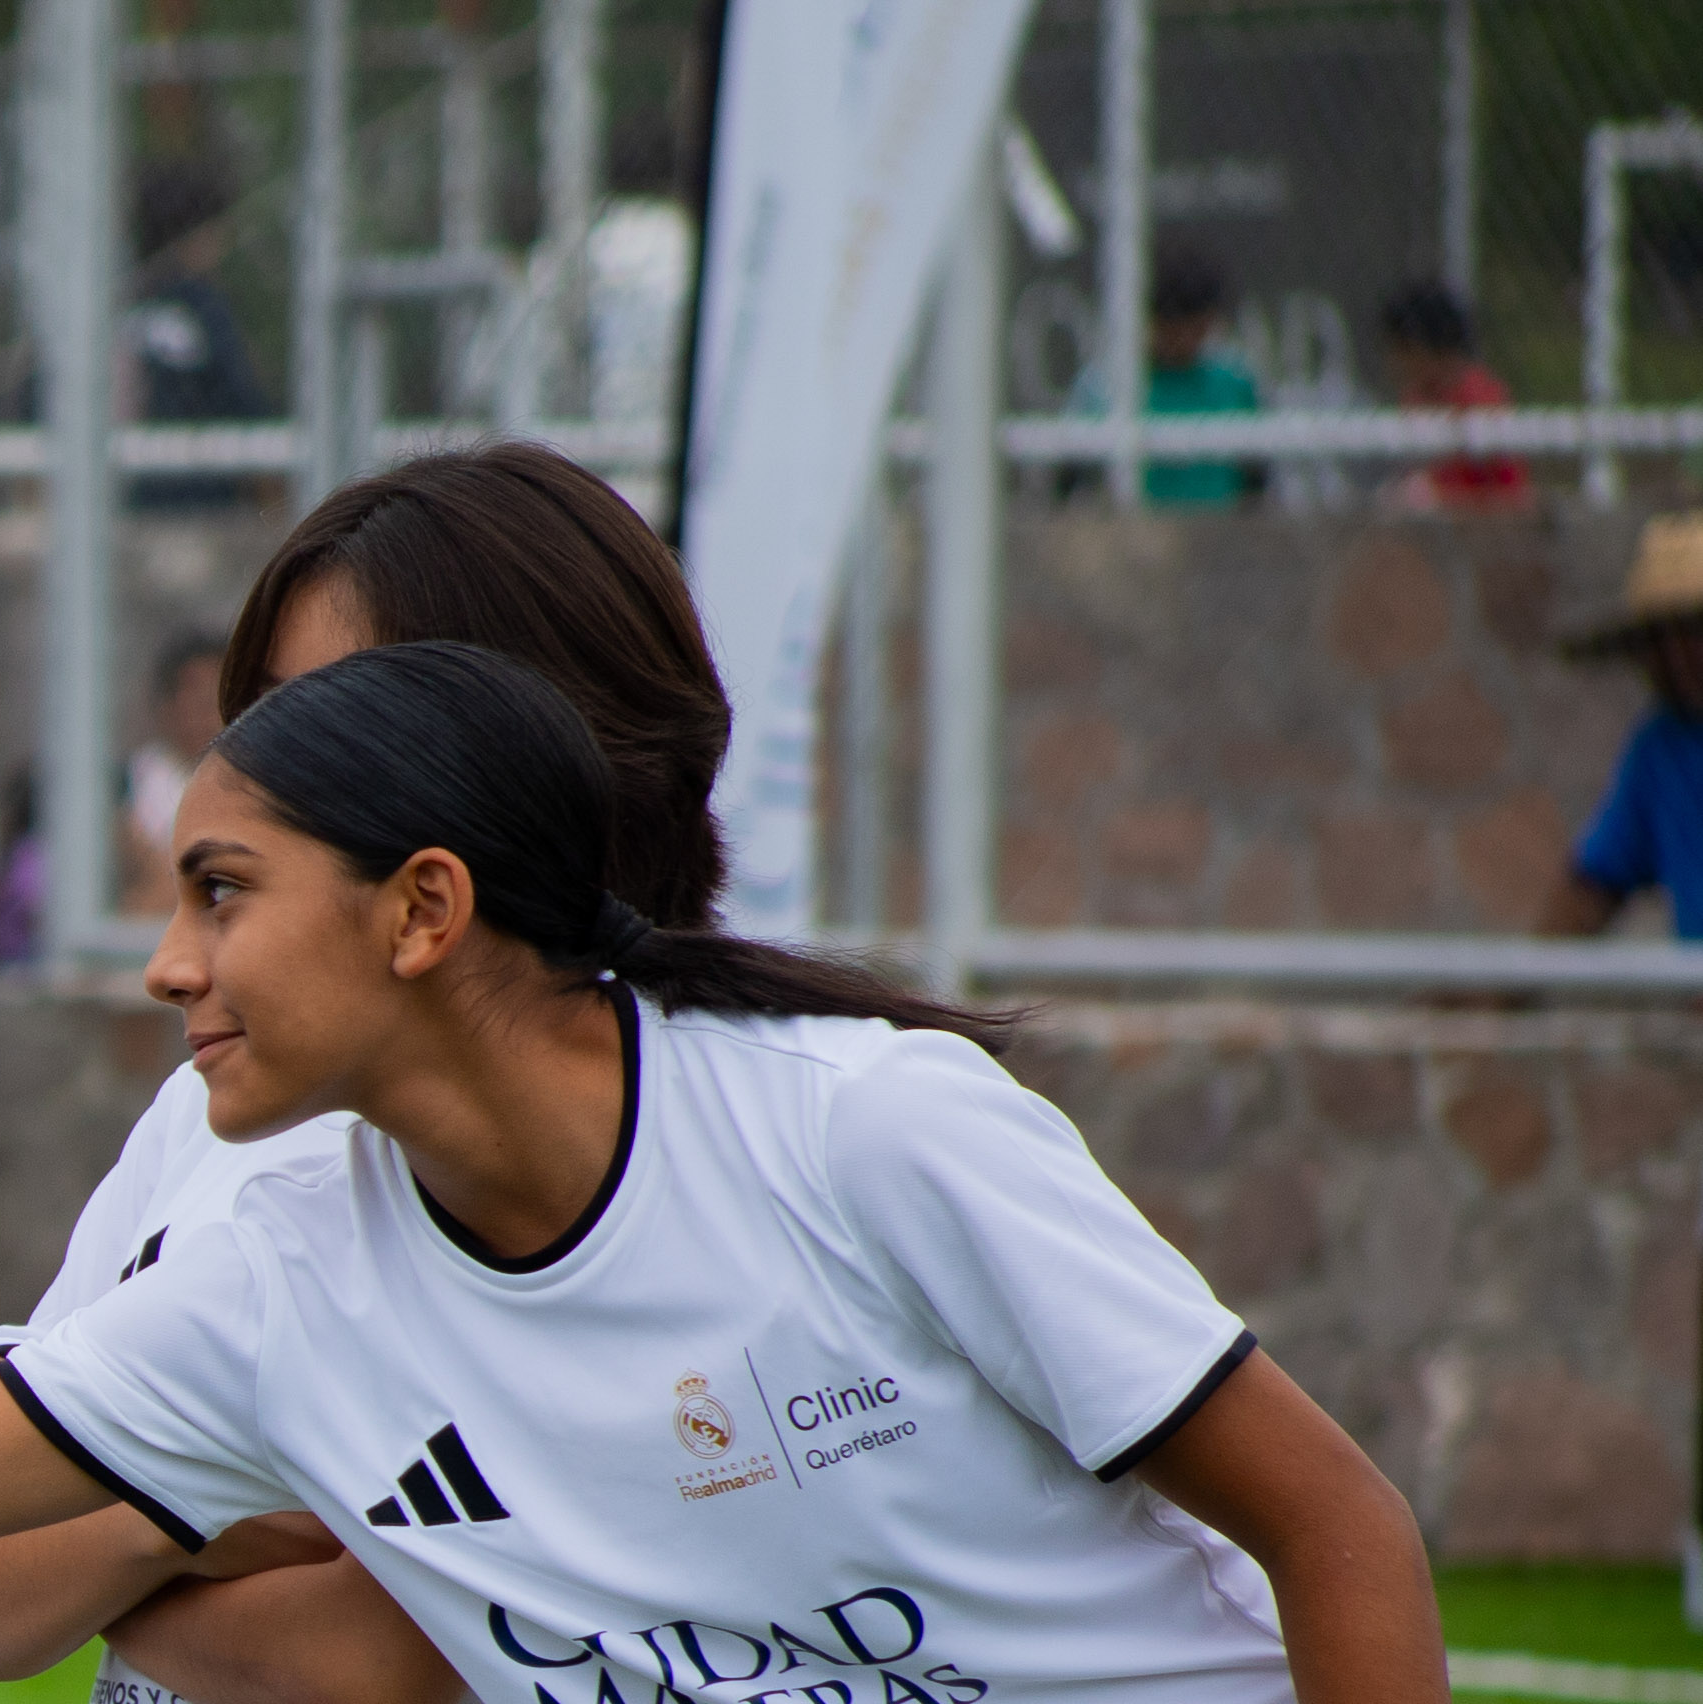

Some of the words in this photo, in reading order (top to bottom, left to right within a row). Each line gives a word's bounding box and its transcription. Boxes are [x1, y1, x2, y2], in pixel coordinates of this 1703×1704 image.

[787, 1376, 899, 1431] Clinic
[805, 1420, 917, 1470] Querétaro
[675, 1453, 771, 1486] FUNDACIÓN
[679, 1463, 778, 1502] Realmadrid
